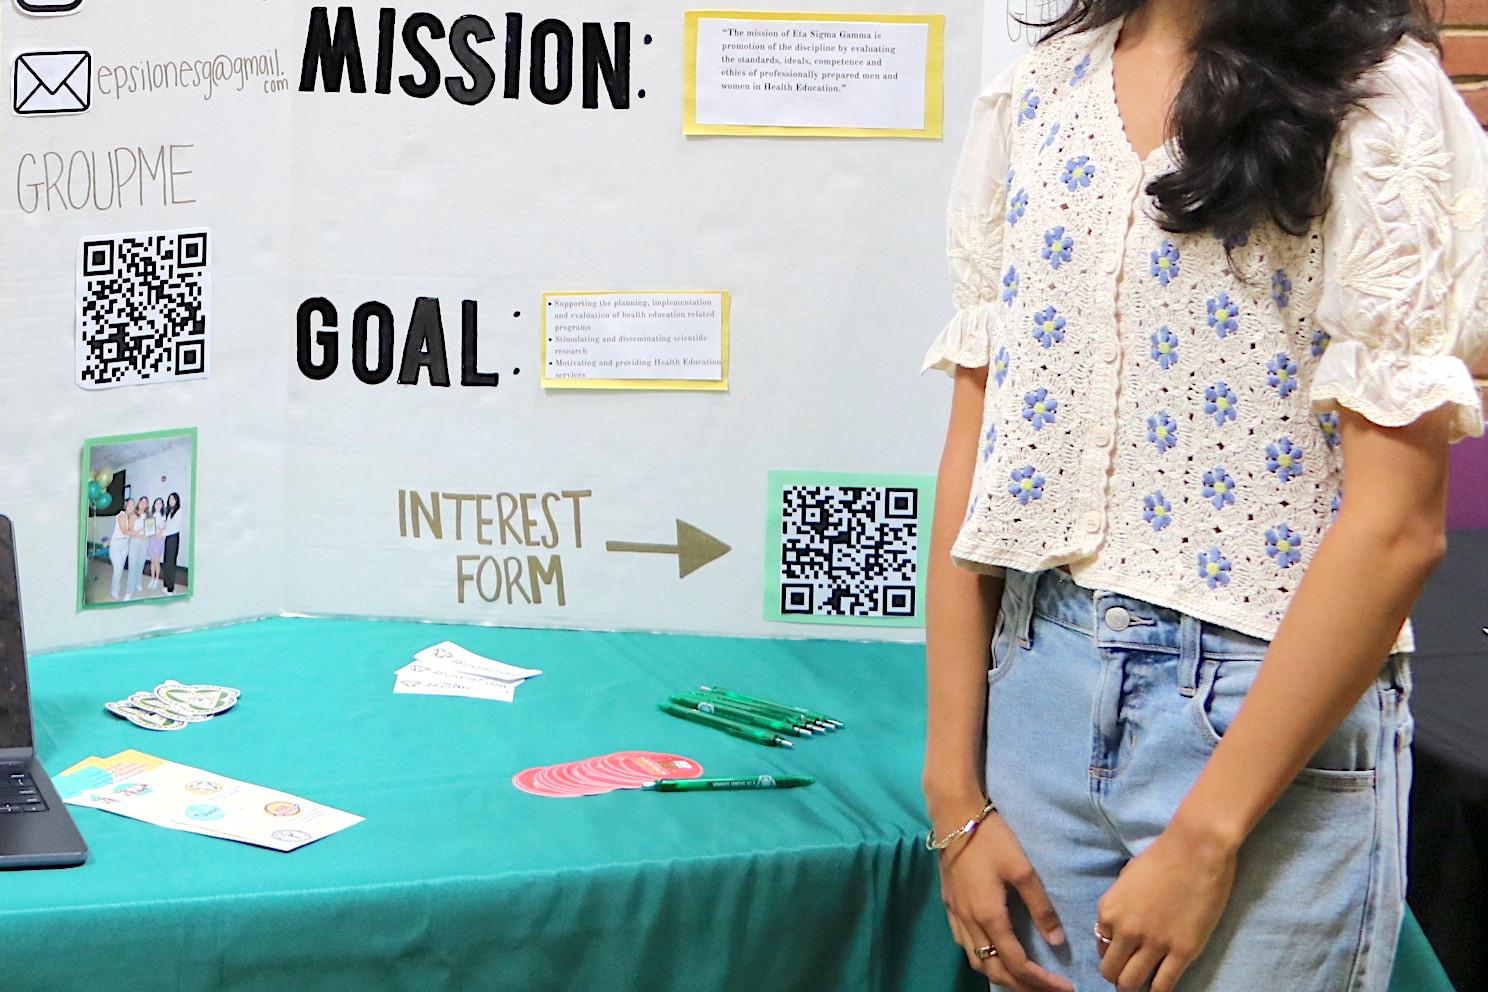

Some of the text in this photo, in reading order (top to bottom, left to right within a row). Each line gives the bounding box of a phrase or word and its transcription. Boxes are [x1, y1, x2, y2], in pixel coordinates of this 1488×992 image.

[793, 30, 807, 38] Eta
[810, 31, 836, 39] Sigma
[839, 31, 871, 39] Gamma
[722, 43, 765, 51] promotion
[779, 43, 792, 51] the
[795, 43, 835, 53] discipline
[838, 44, 847, 54] by
[851, 45, 896, 54] evaluating
[298, 6, 653, 110] MISSION:
[721, 55, 735, 63] the
[784, 57, 811, 65] ideals,
[96, 49, 284, 100] epsilonesg@gmail.
[721, 68, 746, 76] ethics
[749, 69, 757, 77] of
[759, 70, 818, 80] professionally
[822, 71, 859, 80] prepared
[883, 72, 898, 80] and
[264, 79, 288, 94] com
[753, 82, 760, 90] in
[764, 83, 792, 91] Health
[16, 144, 197, 214] GROUPME
[554, 300, 597, 308] Supporting
[614, 299, 650, 308] planning,
[652, 298, 712, 308] implementation
[555, 336, 600, 344] Stimulating
[619, 335, 671, 344] disseminating
[556, 360, 596, 368] Motivating
[615, 359, 652, 368] providing
[654, 358, 680, 366] Health
[397, 488, 593, 549] INTEREST
[456, 554, 567, 607] FORM
